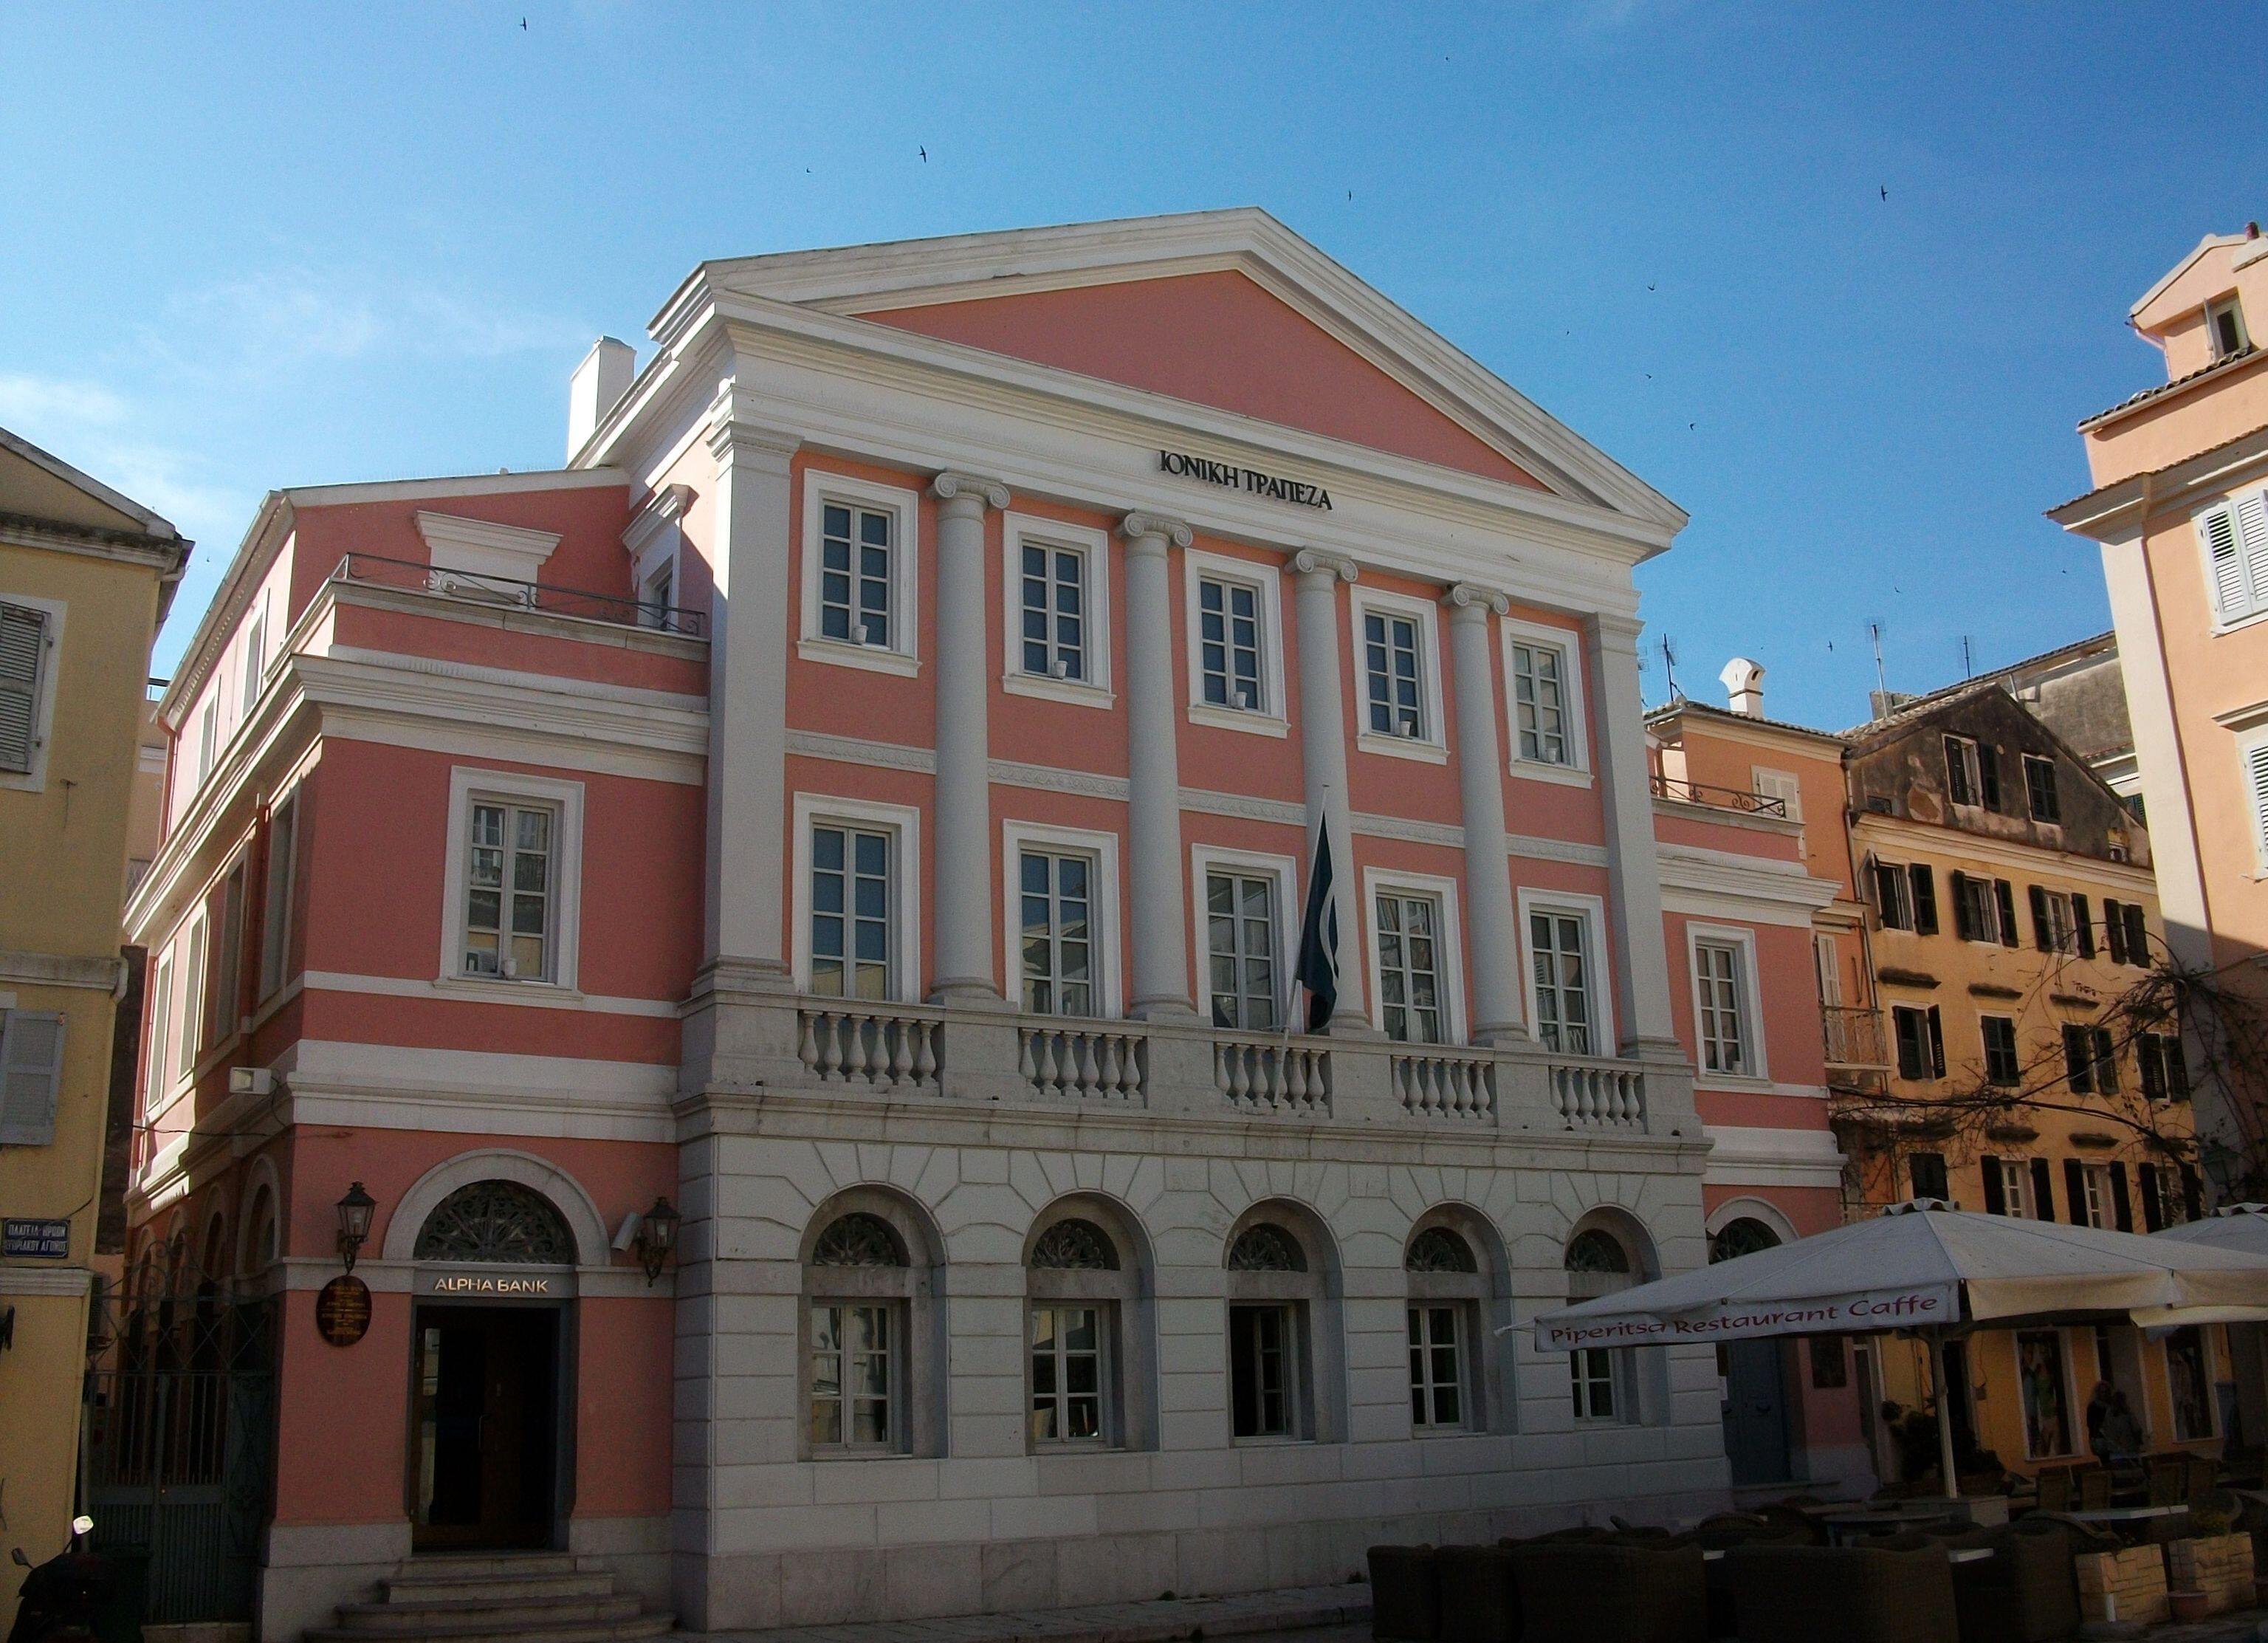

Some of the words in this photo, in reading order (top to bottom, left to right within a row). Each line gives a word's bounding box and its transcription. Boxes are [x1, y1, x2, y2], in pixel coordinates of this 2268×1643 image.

[1160, 450, 1239, 488] ΙΟΝΙΚΗ
[1243, 469, 1333, 510] ΤΡΑΠΕΖΑ
[435, 1277, 493, 1291] ALPHA
[498, 1279, 549, 1292] BANK
[1551, 1322, 1666, 1344] Piperitsa
[1674, 1306, 1838, 1334] Restaurant
[1849, 1294, 1937, 1316] Caffe
